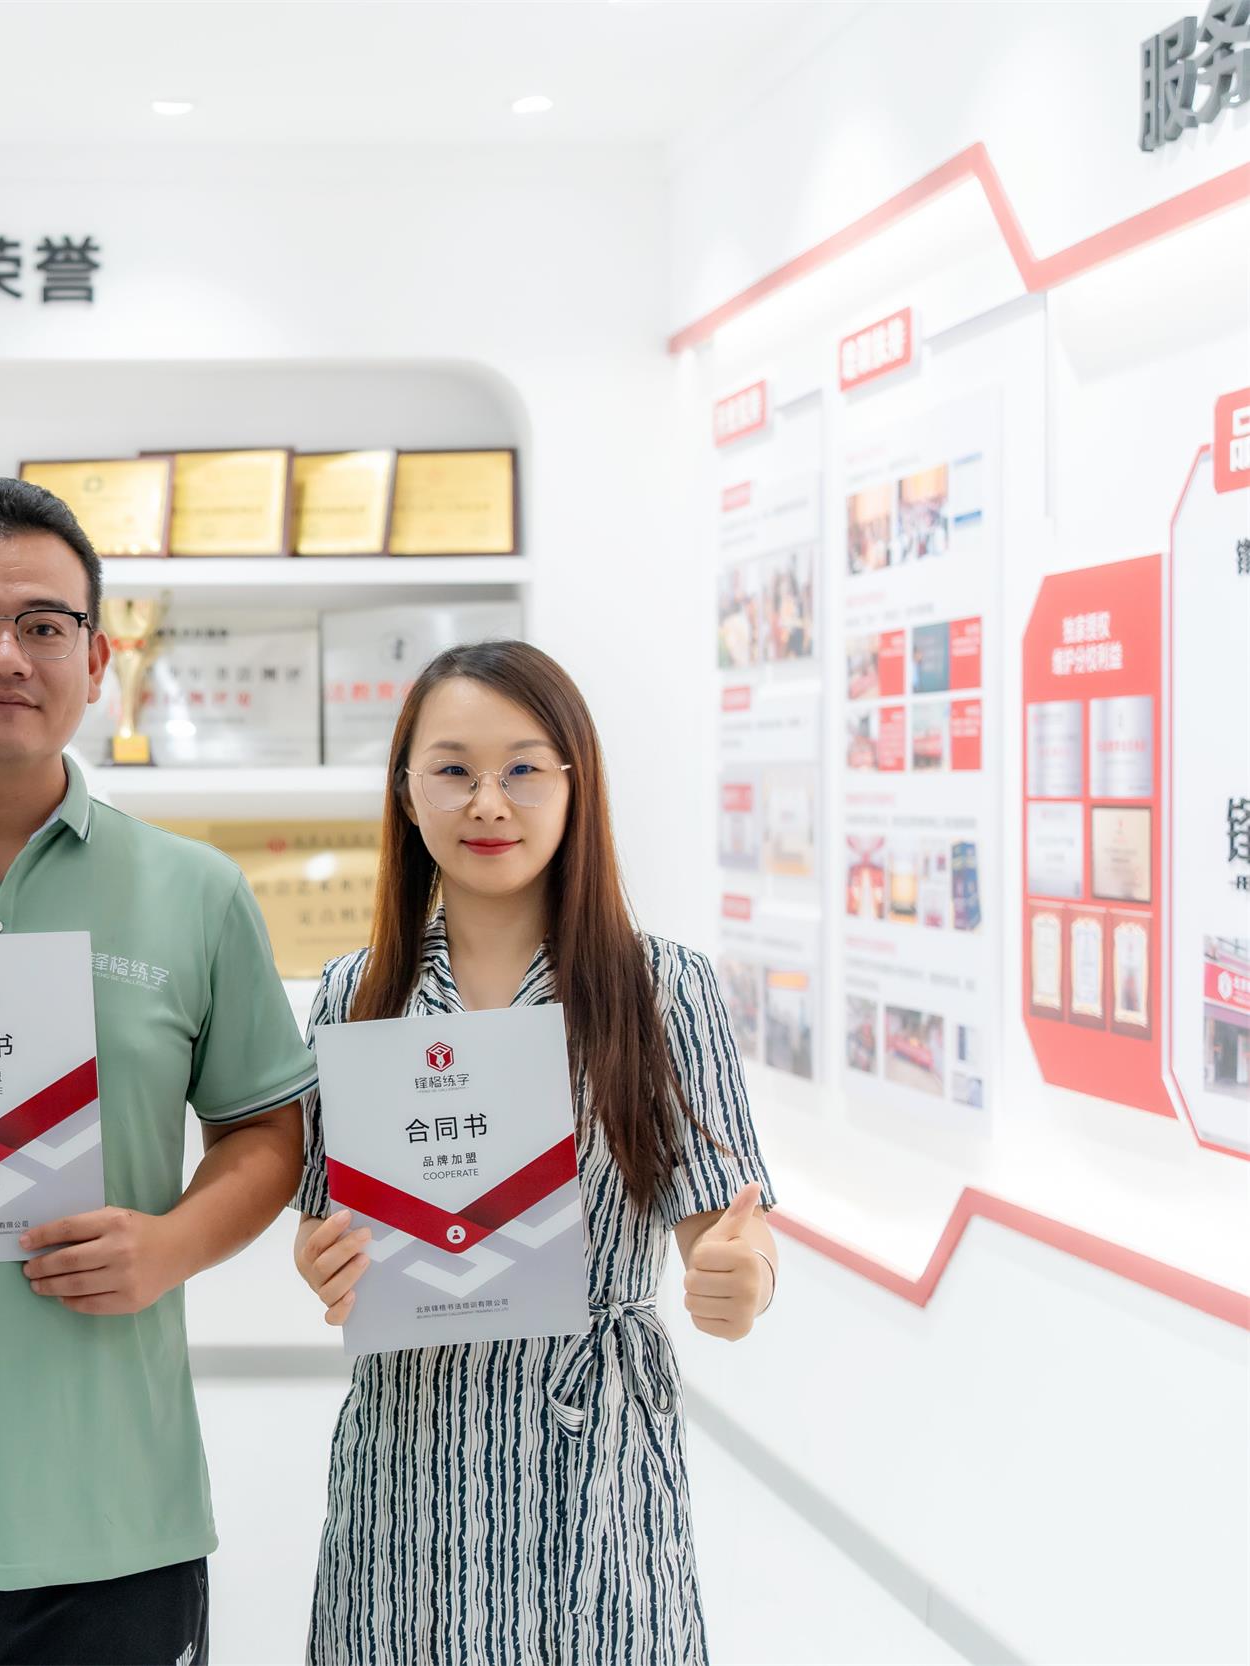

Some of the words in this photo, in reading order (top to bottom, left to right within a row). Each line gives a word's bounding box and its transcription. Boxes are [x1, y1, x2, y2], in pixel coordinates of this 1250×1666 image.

[414, 1073, 469, 1089] 锋格练字
[405, 1113, 487, 1144] 合同书
[422, 1152, 477, 1167] 品牌加盟
[422, 1168, 479, 1181] COOPERATE
